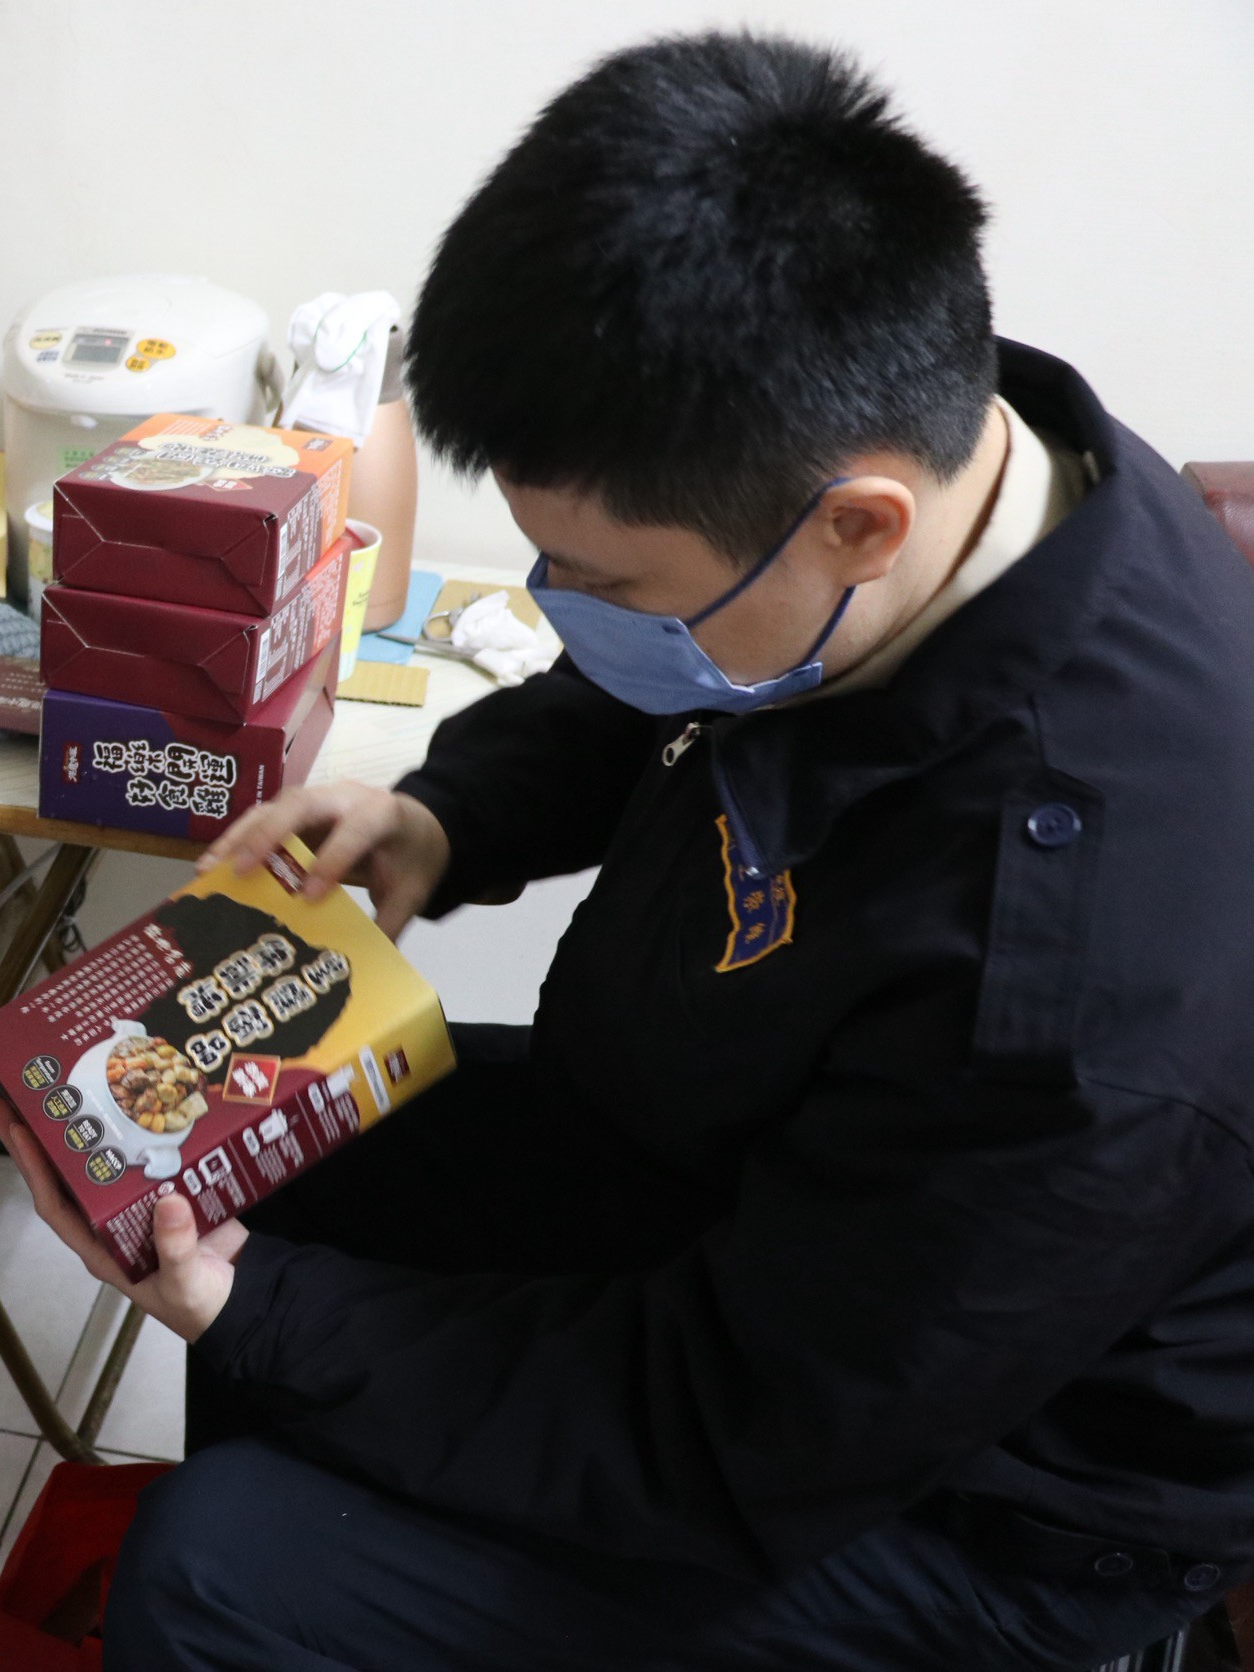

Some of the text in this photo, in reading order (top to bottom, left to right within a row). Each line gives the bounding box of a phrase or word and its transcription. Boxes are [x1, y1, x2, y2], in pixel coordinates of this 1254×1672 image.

[93, 740, 237, 787] 福樂開運
[257, 765, 265, 790] TAIWAN
[126, 776, 229, 819] 好食雞
